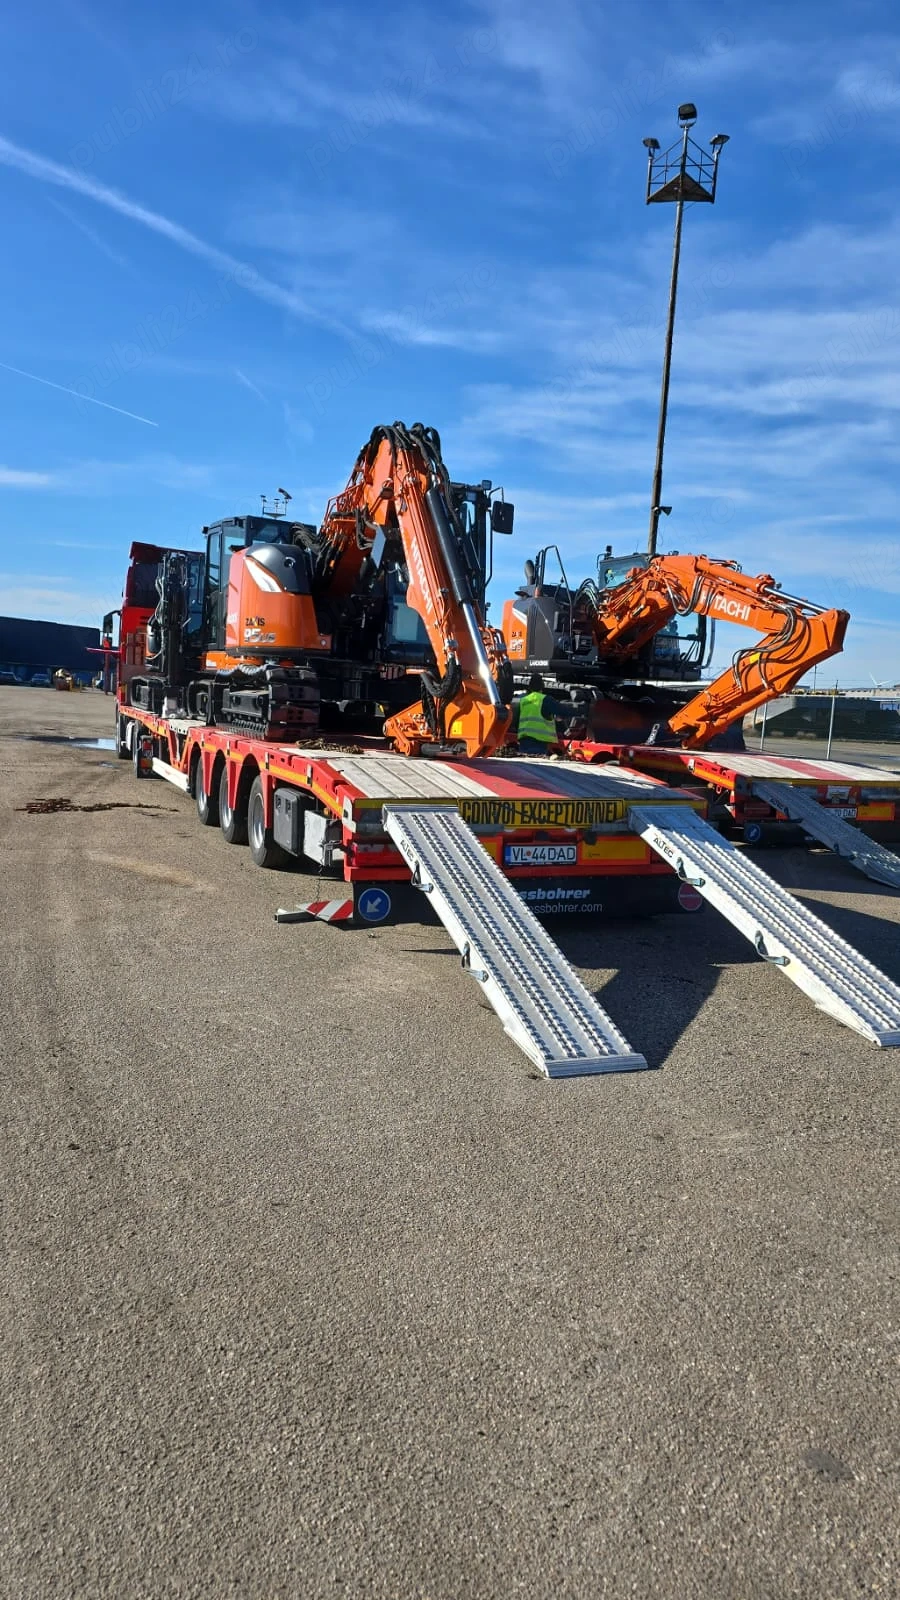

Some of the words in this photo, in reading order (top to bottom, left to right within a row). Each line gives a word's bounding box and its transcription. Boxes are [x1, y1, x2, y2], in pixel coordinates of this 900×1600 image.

[411, 536, 433, 615] HITACHI
[462, 801, 516, 825] CONVOI
[521, 801, 620, 825] EXCEPTIONNEL
[653, 837, 674, 858] ALTEC
